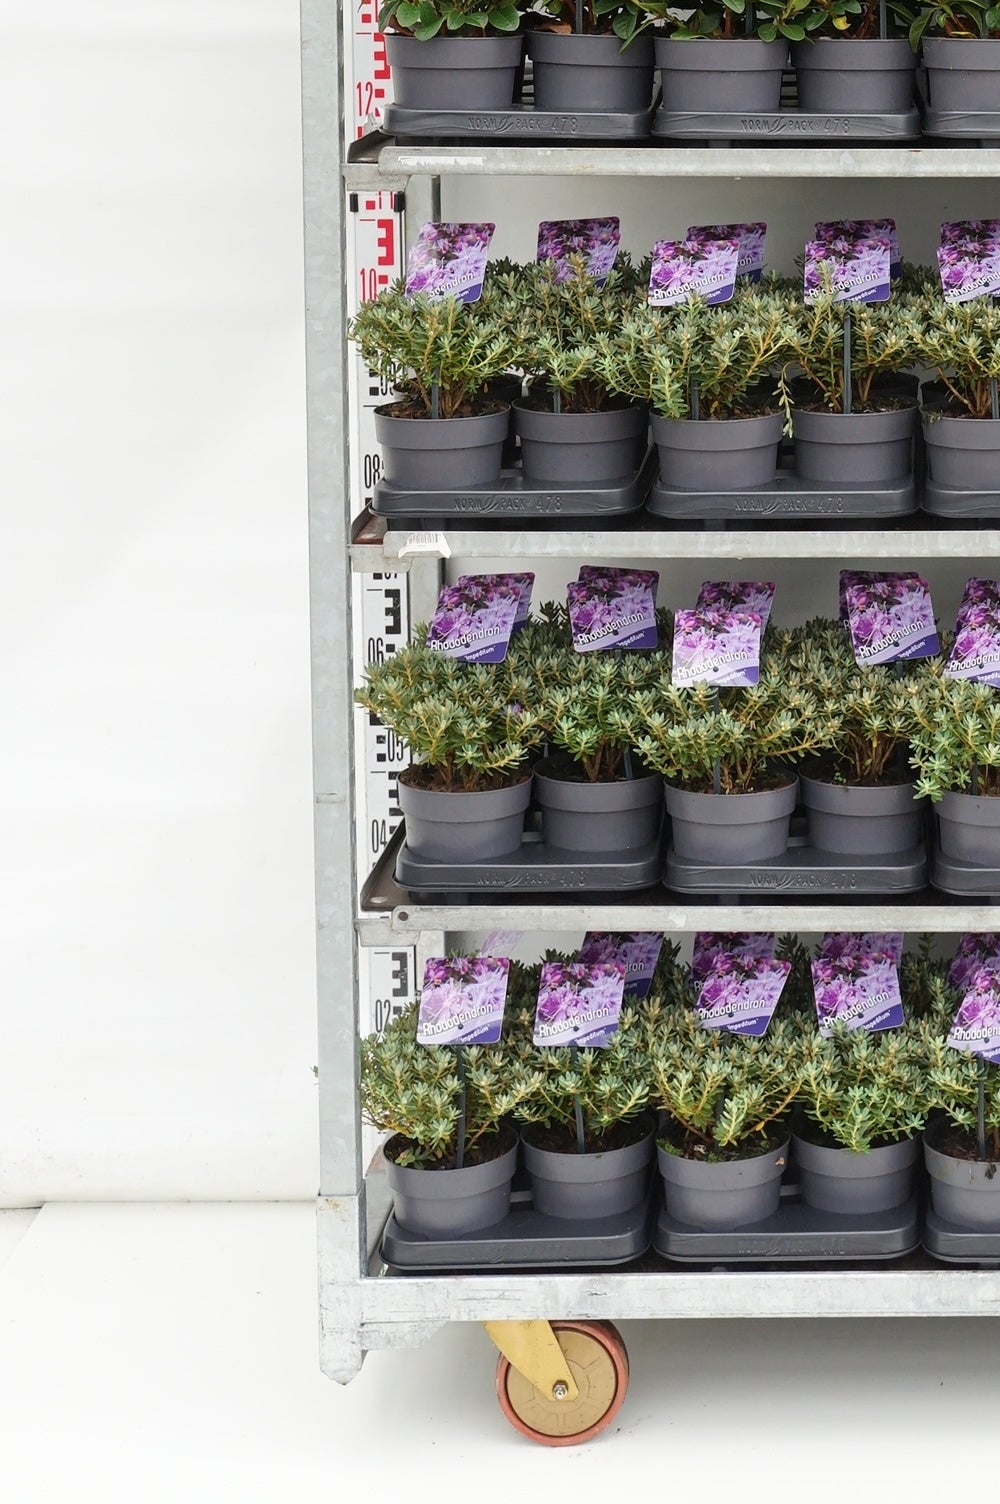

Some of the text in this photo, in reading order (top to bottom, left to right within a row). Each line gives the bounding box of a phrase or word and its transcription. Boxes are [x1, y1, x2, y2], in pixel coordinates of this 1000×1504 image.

[357, 81, 373, 117] 12
[360, 268, 377, 303] 10
[654, 274, 725, 300] Rhododendron
[365, 454, 380, 489] 08
[430, 625, 499, 650] Rhododendron
[578, 611, 644, 644] Rhododendron
[859, 622, 924, 657] Rhododendron
[368, 637, 384, 665] 06
[676, 649, 748, 677] Rhododendron
[387, 727, 404, 762] 05
[372, 819, 387, 853] 04
[423, 1003, 494, 1036] Rhododendron
[539, 1006, 610, 1038] Rhododendron
[699, 998, 766, 1020] Rhododendron
[823, 991, 891, 1028] Rhododendron
